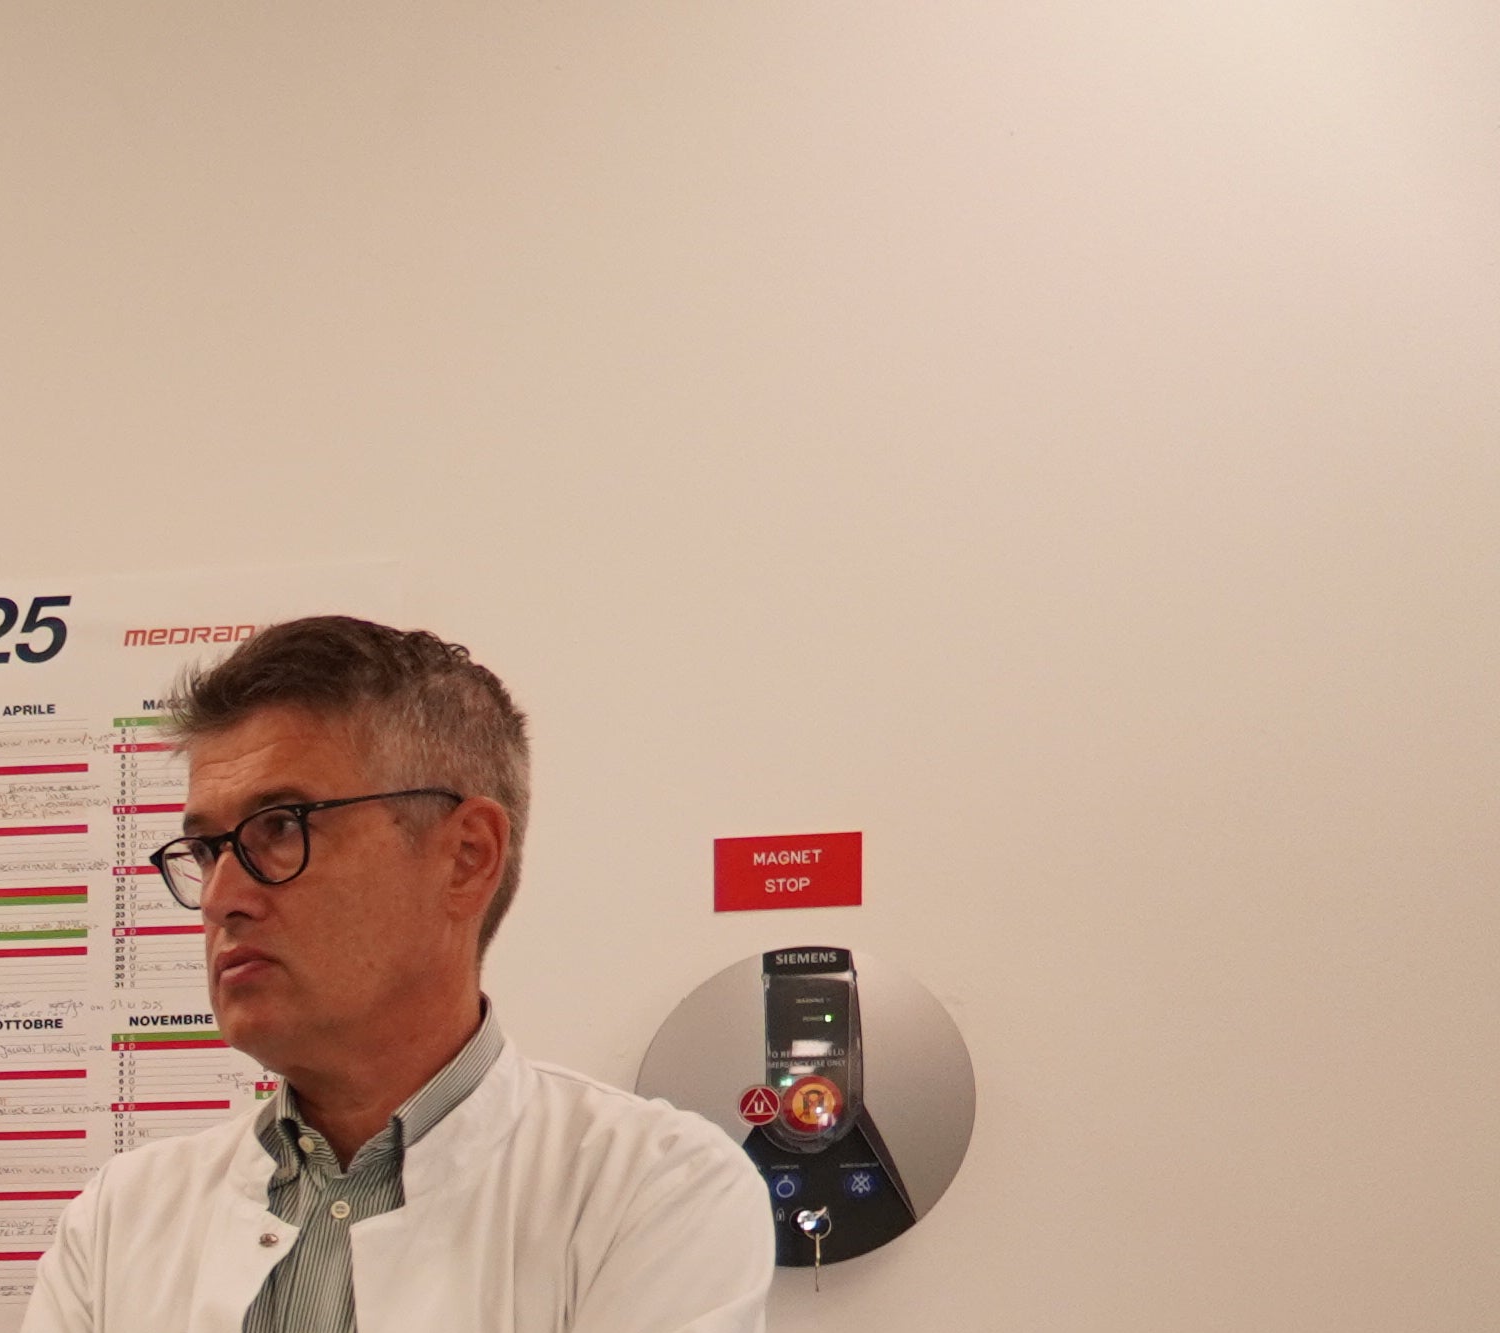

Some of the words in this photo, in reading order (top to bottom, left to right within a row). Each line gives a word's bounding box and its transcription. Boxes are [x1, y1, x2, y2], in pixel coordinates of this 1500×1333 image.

[2, 704, 56, 716] APRILE
[753, 848, 823, 867] MAGNET
[764, 876, 812, 894] STOP
[775, 951, 838, 965] SIEMENS
[129, 1014, 214, 1027] NOVEMBRE
[753, 1101, 764, 1116] U
